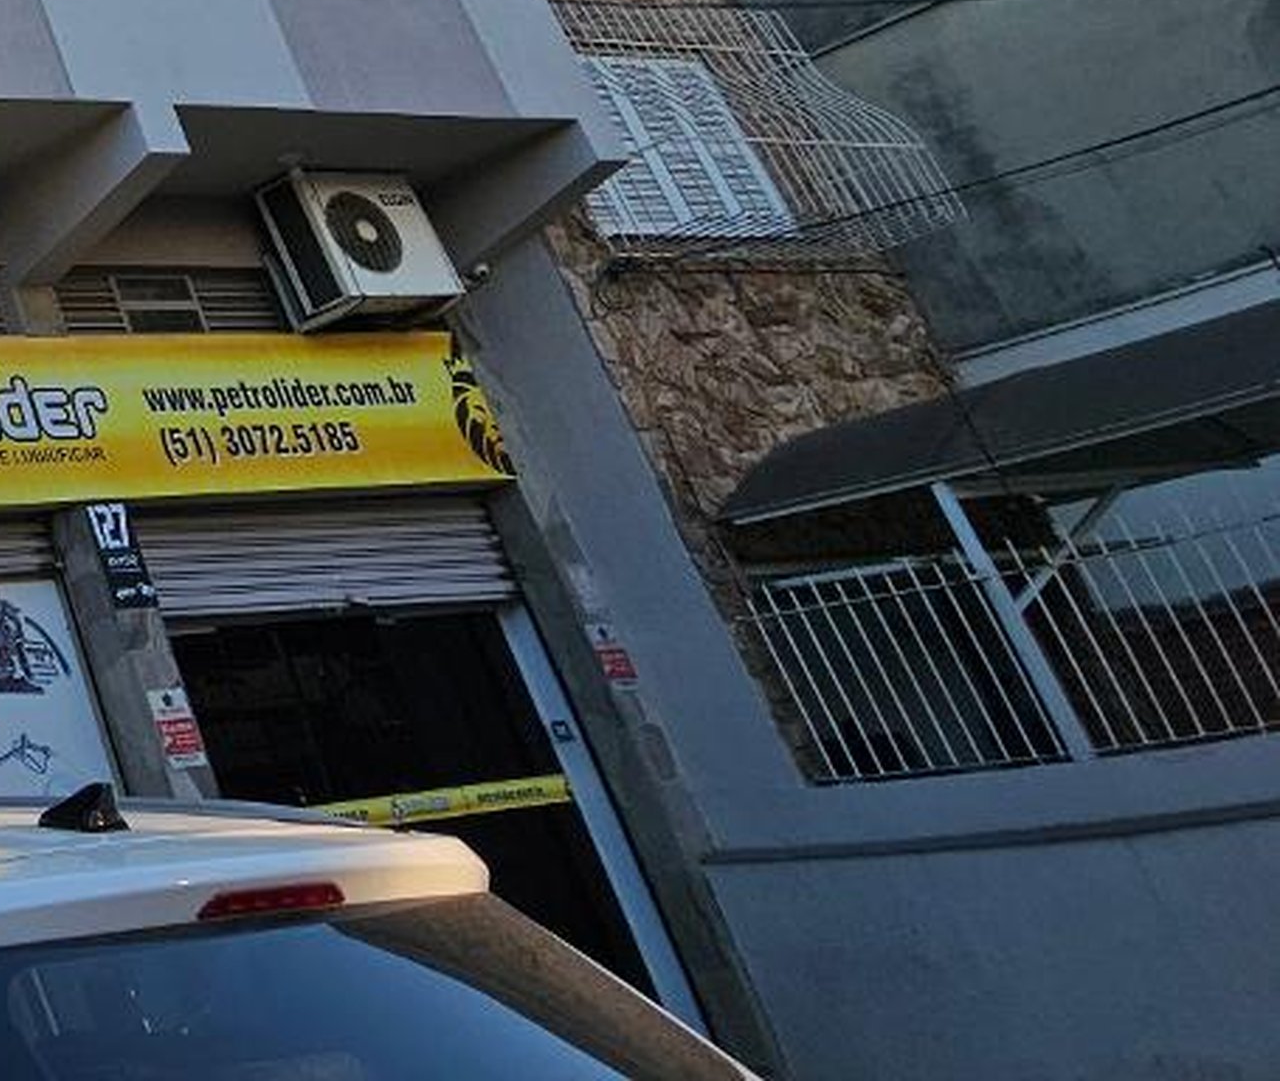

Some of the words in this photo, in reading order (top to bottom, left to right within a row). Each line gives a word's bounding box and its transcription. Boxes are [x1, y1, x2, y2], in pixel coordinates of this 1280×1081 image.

[142, 377, 417, 417] www.petrolider.com.br
[160, 427, 216, 467] (51)
[220, 421, 361, 456] 3072.5185
